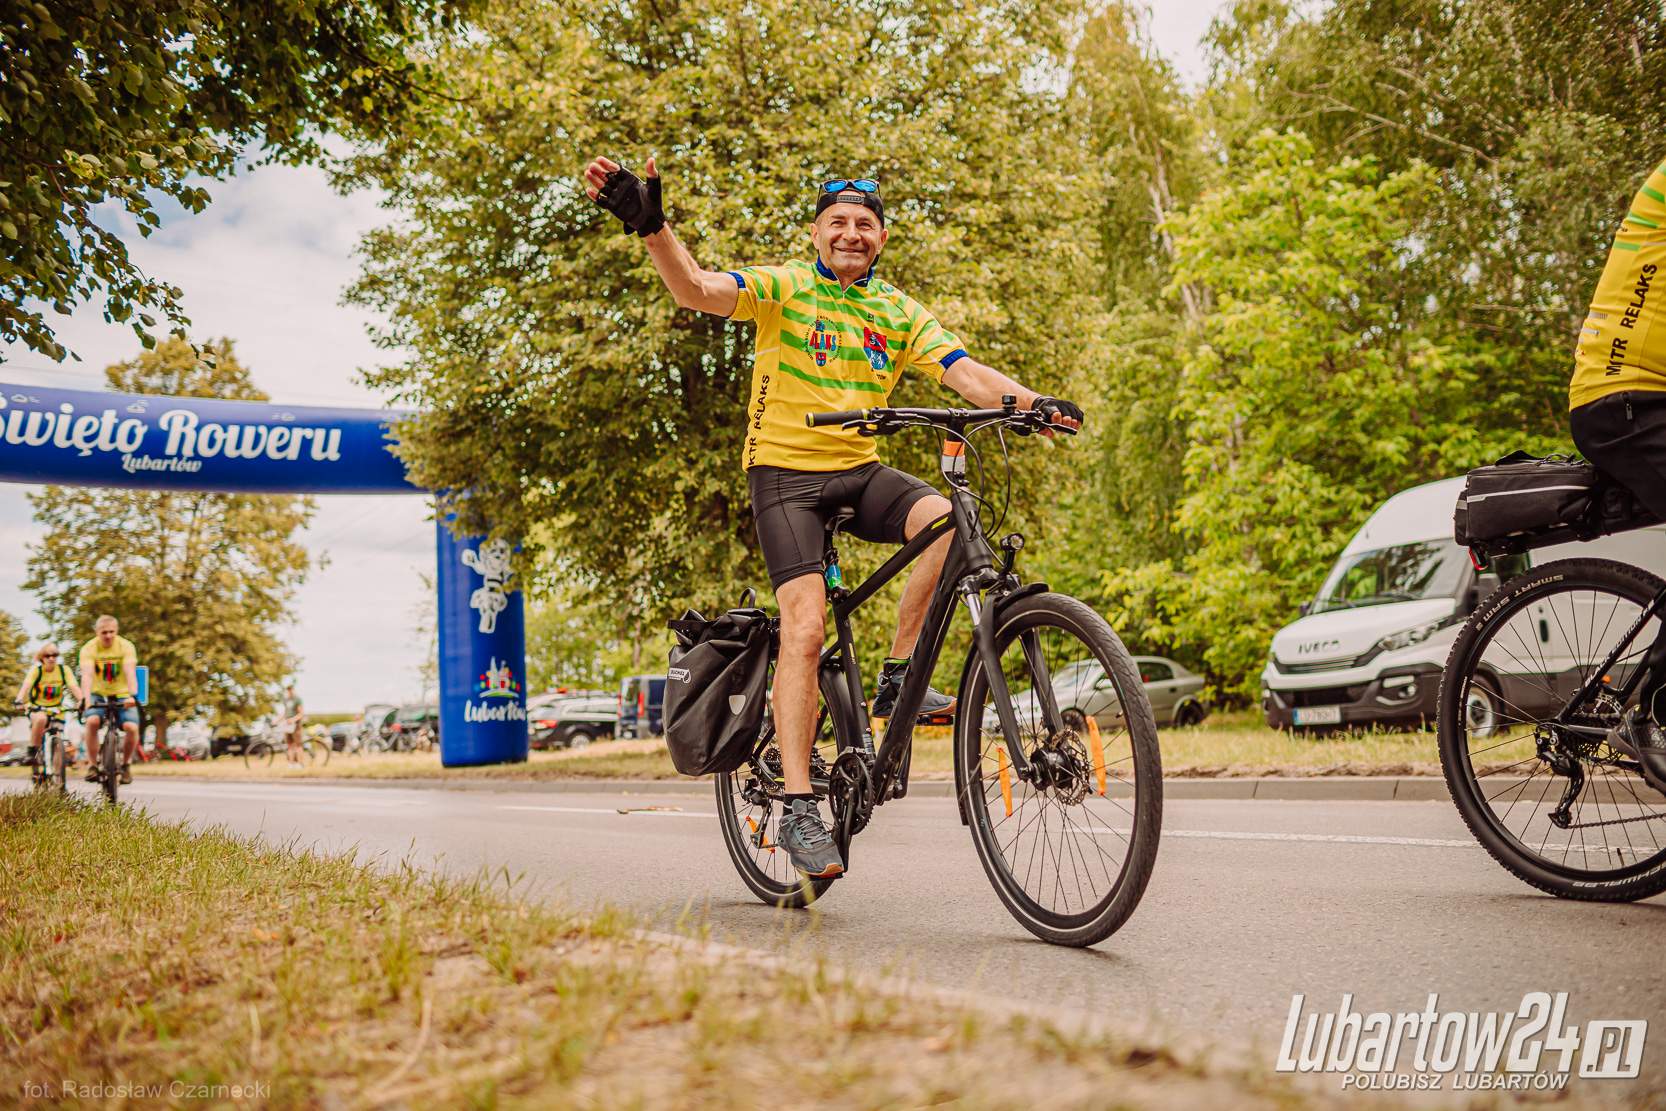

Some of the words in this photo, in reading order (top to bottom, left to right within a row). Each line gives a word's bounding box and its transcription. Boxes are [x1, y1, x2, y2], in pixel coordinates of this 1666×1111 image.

[1620, 263, 1658, 329] RELAKS
[754, 374, 770, 429] RELAKS
[159, 409, 342, 461] Roweru
[121, 453, 202, 473] Lubartów
[1514, 574, 1564, 598] SMART
[1483, 596, 1510, 622] SAM
[1298, 639, 1340, 655] IVECO
